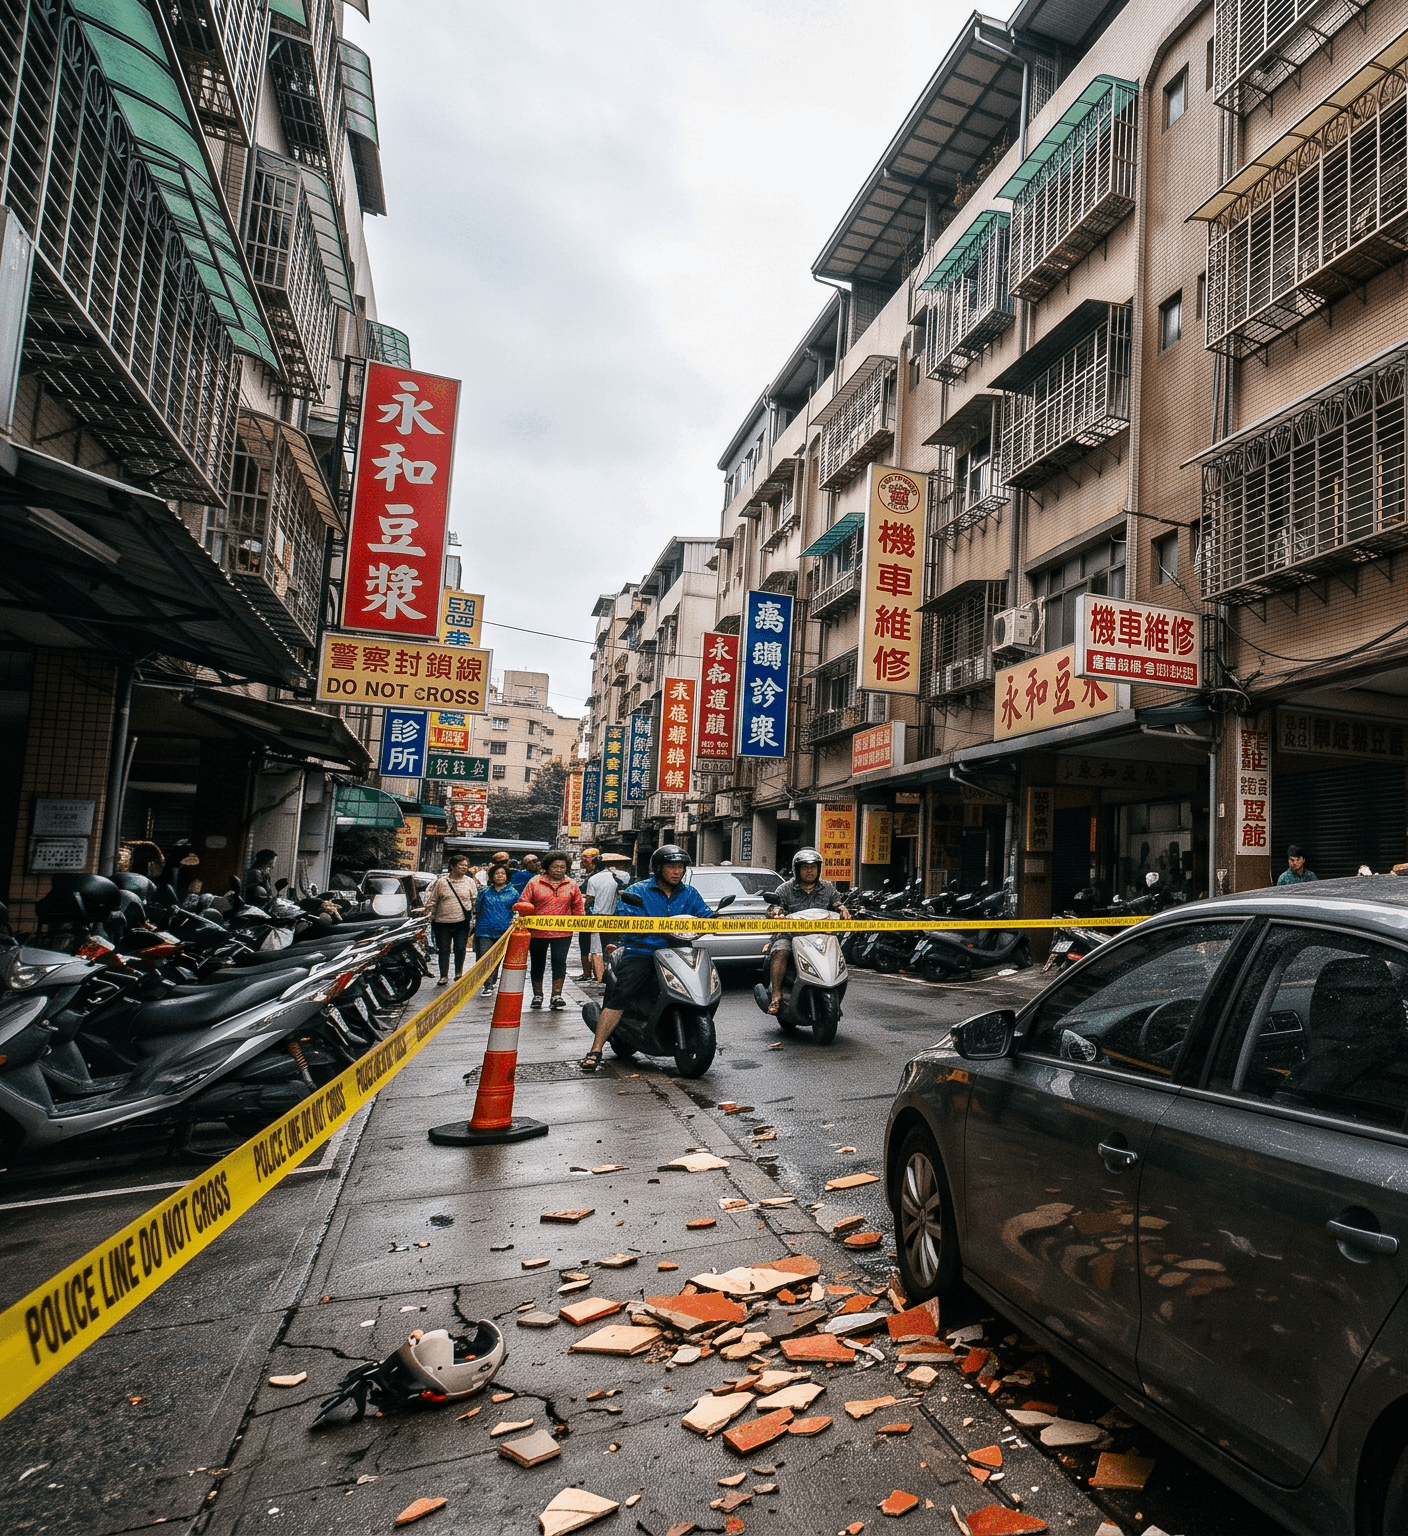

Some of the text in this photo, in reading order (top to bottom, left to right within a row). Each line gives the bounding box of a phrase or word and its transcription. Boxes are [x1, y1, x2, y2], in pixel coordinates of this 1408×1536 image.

[360, 380, 446, 621] 永和豆漿
[872, 519, 916, 683] 機車維修
[1090, 602, 1195, 656] 機車維修
[326, 677, 358, 696] DO
[364, 680, 410, 700] NOT
[330, 642, 483, 683] 警察封鎖線
[387, 709, 425, 774] 診所
[252, 1127, 287, 1184] POLICE
[284, 1114, 304, 1158] LINE
[301, 1106, 314, 1145] DO
[311, 1095, 327, 1136] NOT
[24, 1170, 232, 1367] POLICE LINE DO NOT CROSS
